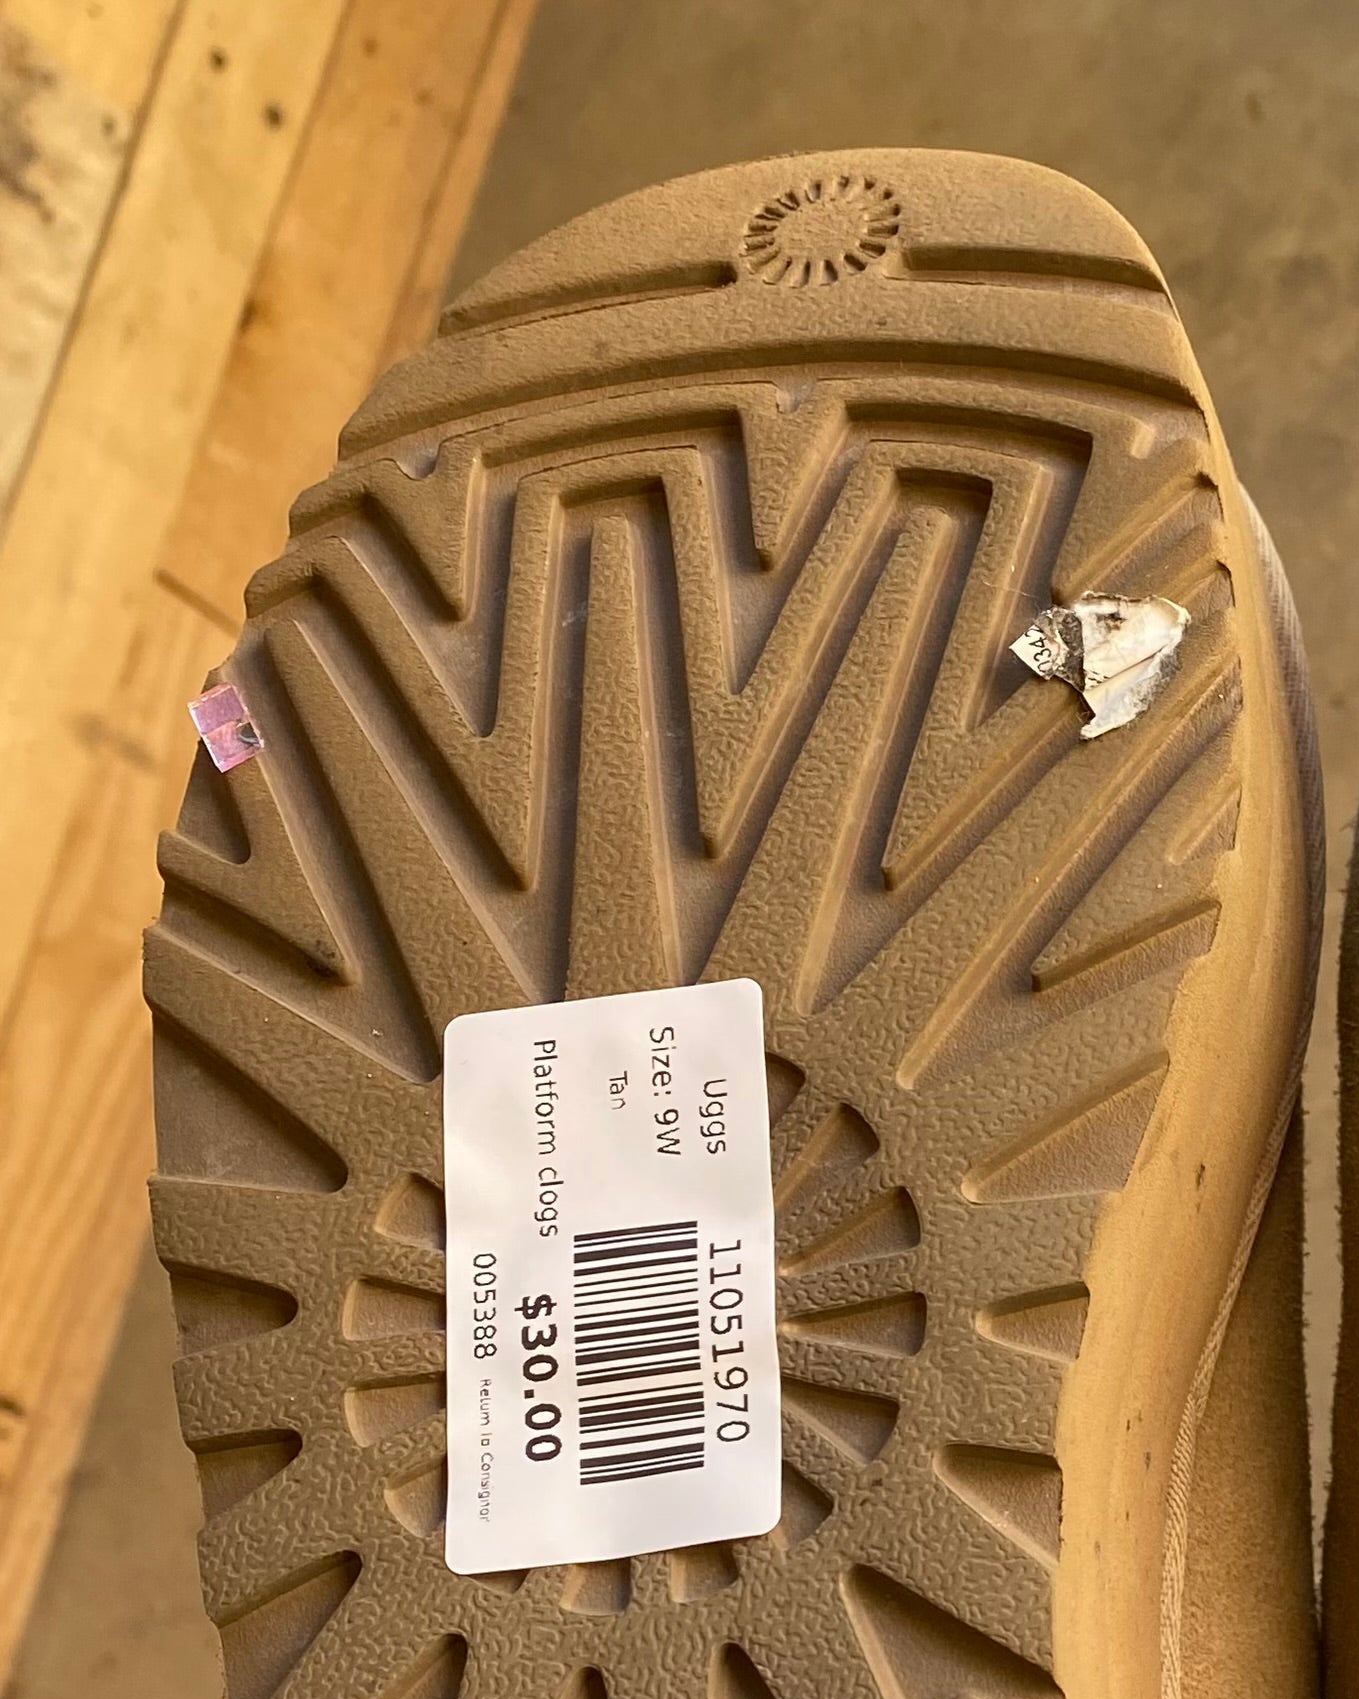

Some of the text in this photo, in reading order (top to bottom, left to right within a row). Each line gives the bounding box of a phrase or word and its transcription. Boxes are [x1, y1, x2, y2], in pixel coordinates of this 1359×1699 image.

[533, 1039, 564, 1238] Platform clogs
[609, 1070, 628, 1110] Tan
[649, 1026, 681, 1156] Size: 9W
[699, 1078, 728, 1154] Uggs
[472, 1253, 497, 1359] 005388
[709, 1239, 750, 1442] 11051970
[514, 1293, 562, 1462] $30.00
